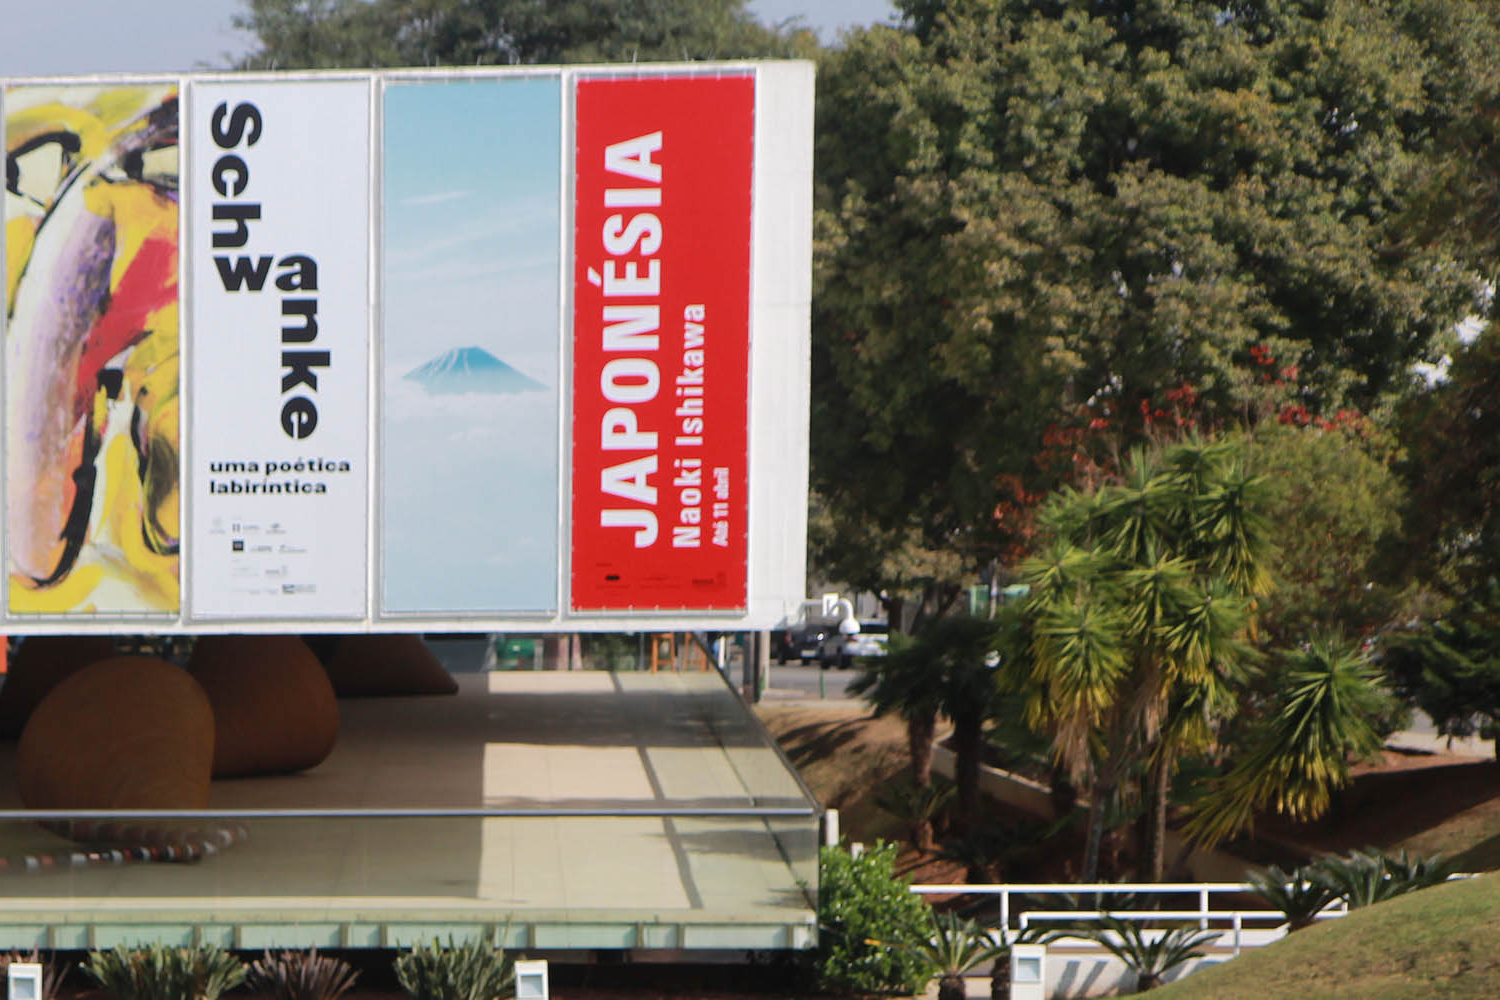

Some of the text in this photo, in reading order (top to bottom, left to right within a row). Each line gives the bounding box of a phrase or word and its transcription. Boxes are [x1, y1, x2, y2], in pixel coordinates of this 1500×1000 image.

[587, 130, 663, 548] JAPONÉSIA
[672, 303, 706, 548] Naoki Ishikawa
[209, 457, 351, 476] uma poética
[209, 478, 328, 495] labiríntica
[713, 502, 729, 518] 11
[712, 520, 729, 548] Até
